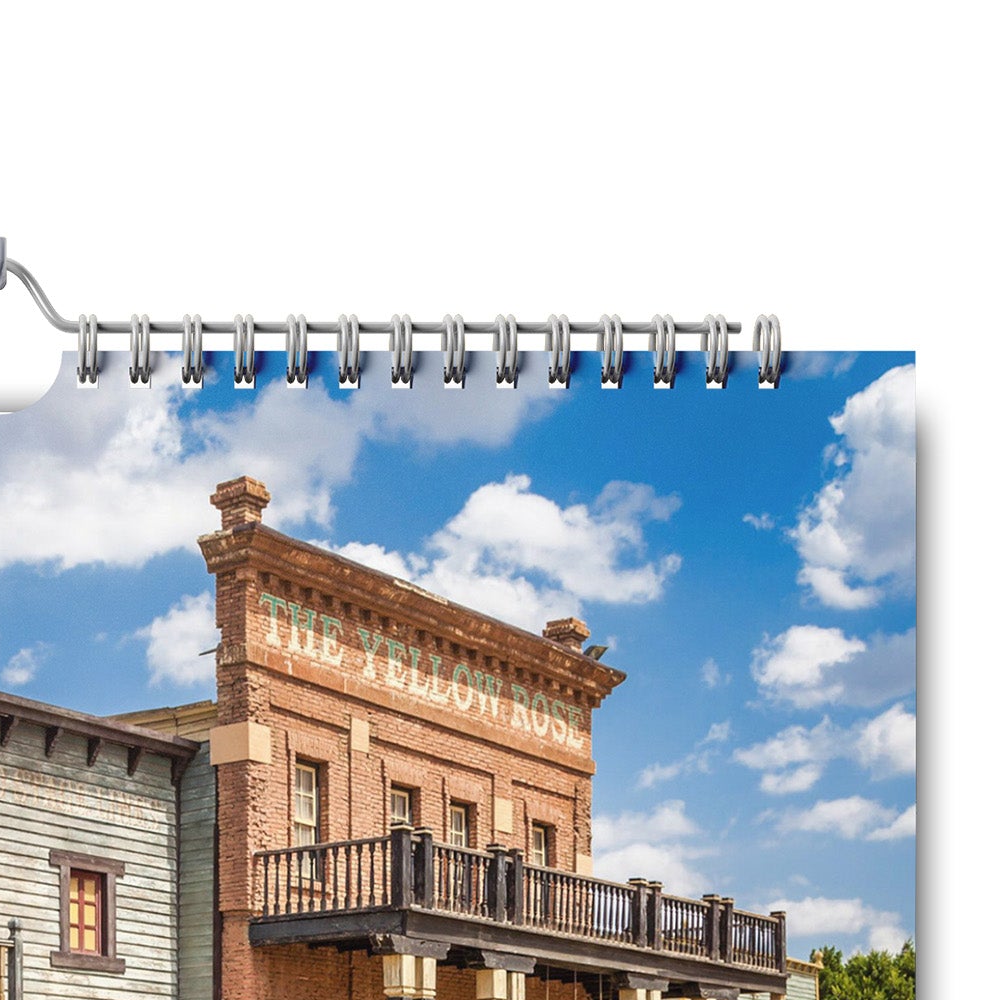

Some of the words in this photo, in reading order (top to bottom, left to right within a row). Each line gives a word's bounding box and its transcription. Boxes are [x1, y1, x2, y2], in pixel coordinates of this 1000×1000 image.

[259, 593, 344, 666] THE
[358, 628, 503, 719] YELLOW
[510, 683, 585, 749] ROSE
